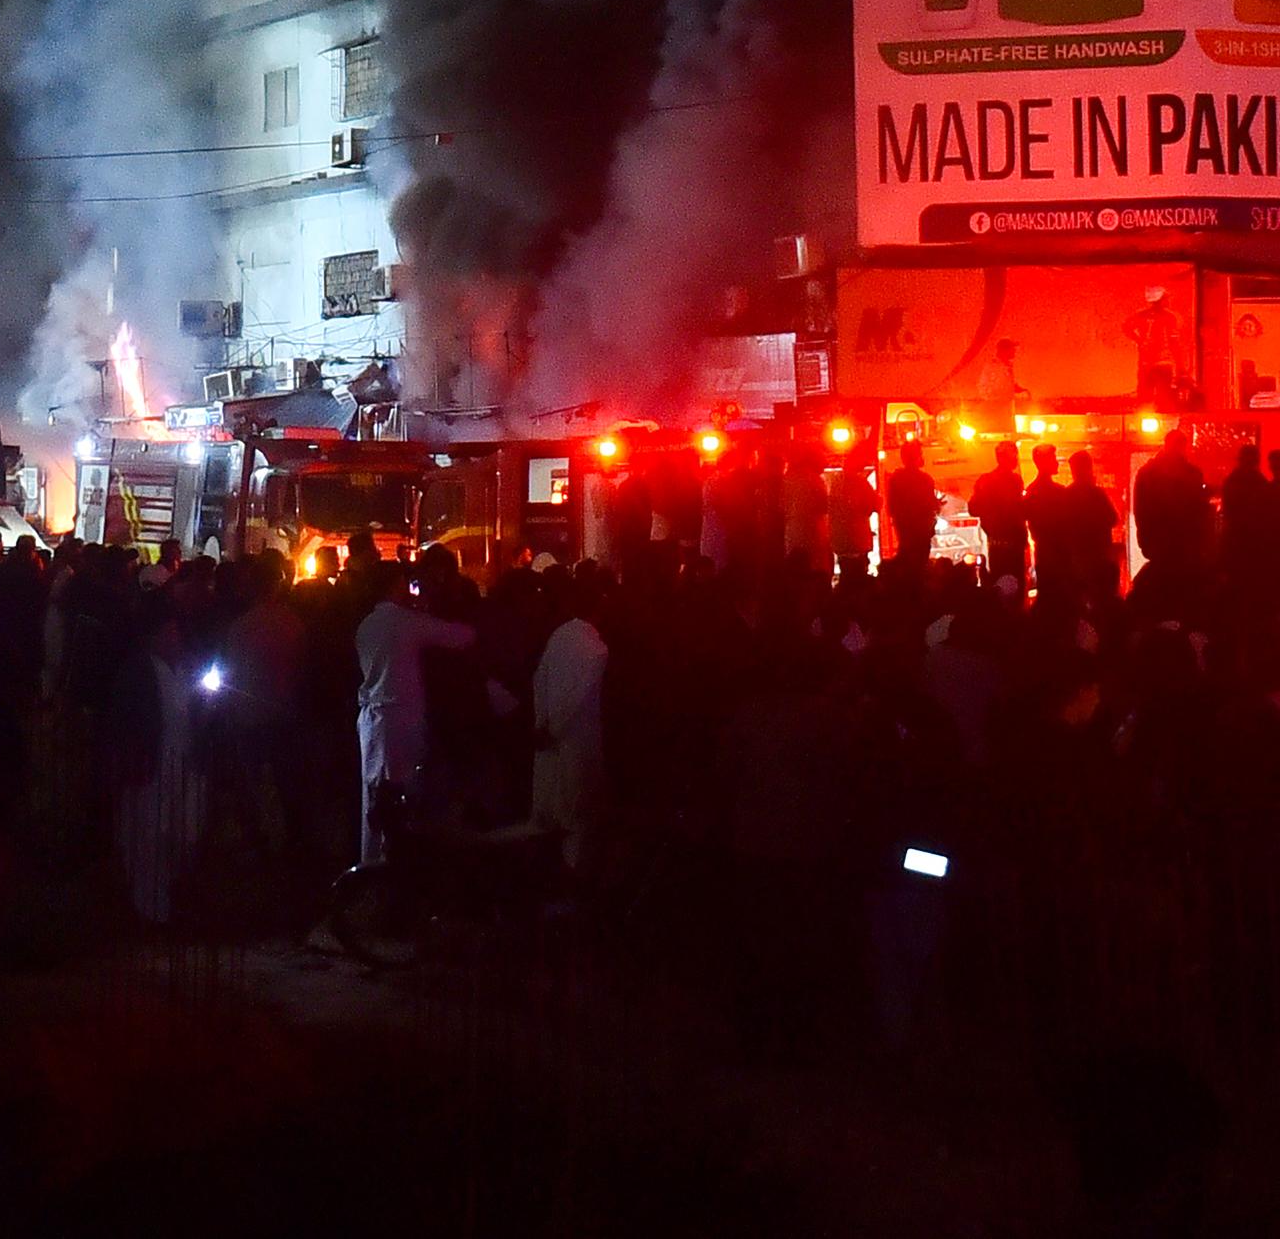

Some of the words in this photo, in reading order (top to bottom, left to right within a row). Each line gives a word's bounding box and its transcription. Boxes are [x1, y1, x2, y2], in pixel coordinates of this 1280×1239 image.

[898, 45, 1048, 65] SULPHATE-FREE
[1055, 40, 1165, 59] HANDWASH
[877, 98, 1053, 184] MADE
[1072, 96, 1128, 178] IN
